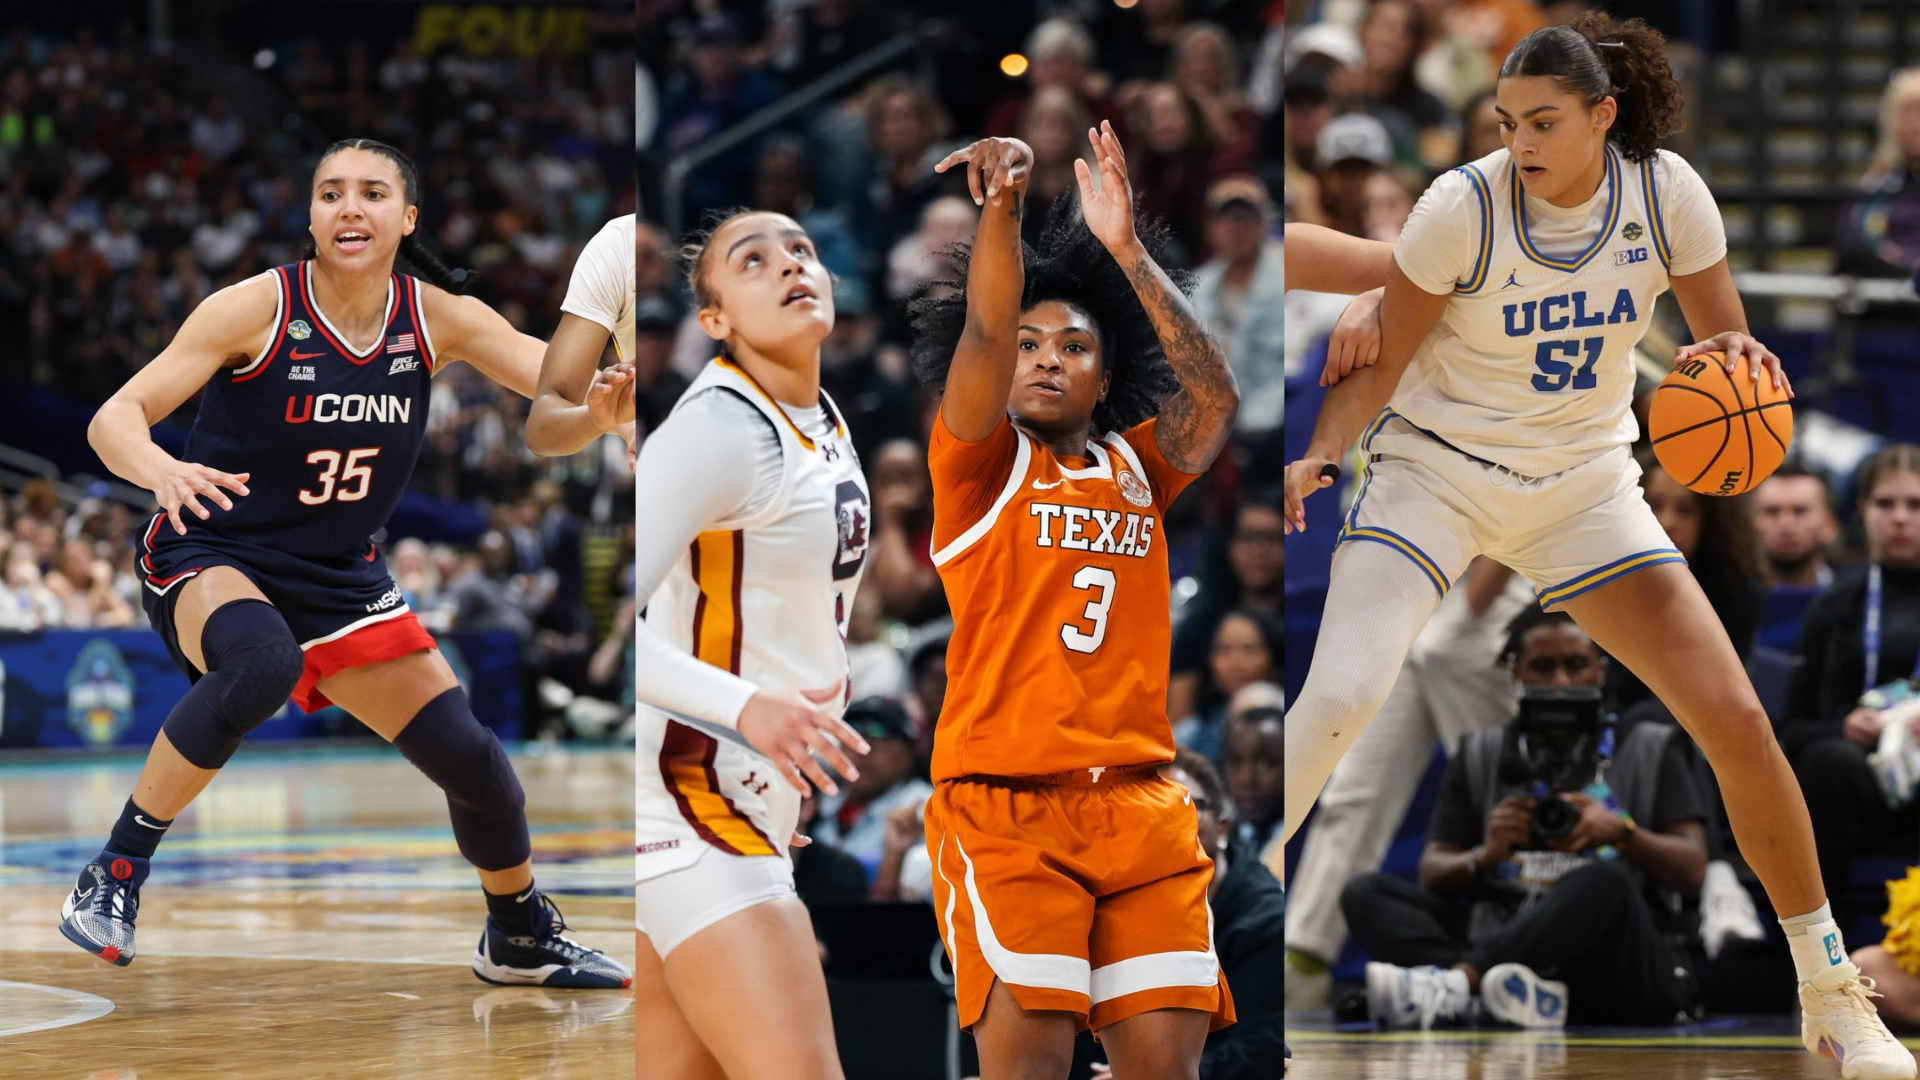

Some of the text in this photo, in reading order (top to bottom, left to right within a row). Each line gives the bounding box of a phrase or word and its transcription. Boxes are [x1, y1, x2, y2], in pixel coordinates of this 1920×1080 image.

[1503, 289, 1637, 337] UCLA
[288, 373, 316, 381] CHANGE
[291, 365, 316, 374] BE THE
[389, 362, 420, 372] EAST
[393, 356, 414, 364] BIG
[1531, 336, 1604, 391] 51
[285, 393, 411, 424] UCONN
[298, 447, 381, 505] 35
[1030, 503, 1155, 558] TEXAS
[1060, 565, 1117, 654] 3
